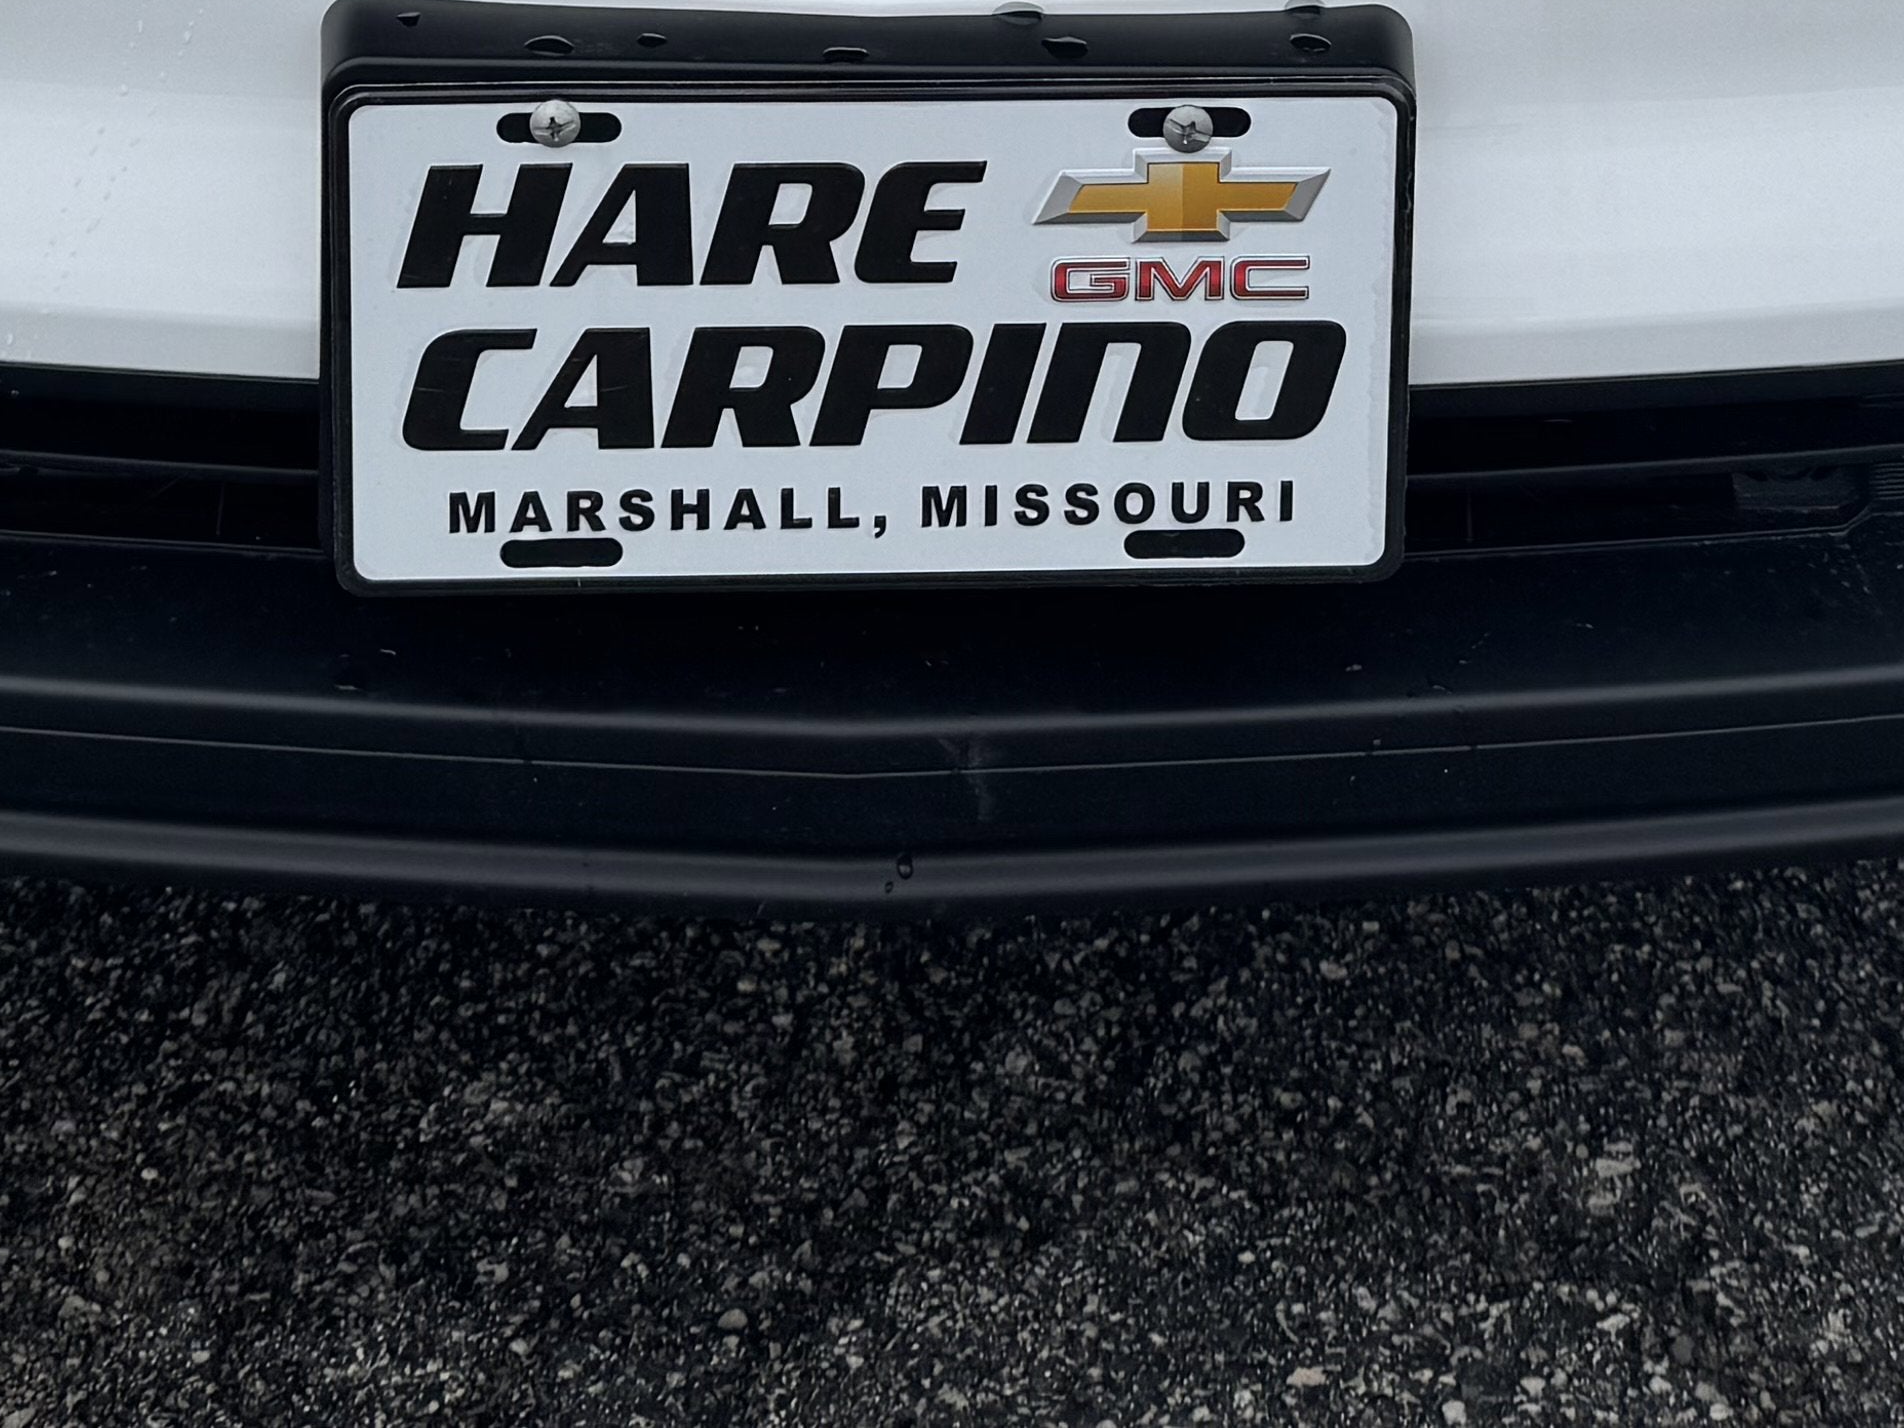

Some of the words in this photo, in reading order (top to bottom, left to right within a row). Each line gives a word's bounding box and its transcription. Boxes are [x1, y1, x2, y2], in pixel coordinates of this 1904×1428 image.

[396, 160, 989, 289] HARE
[1049, 254, 1311, 302] GMC
[401, 320, 1348, 452] CARPINO
[449, 486, 890, 538] MARSHALL,
[920, 480, 1295, 528] MISSOURI
